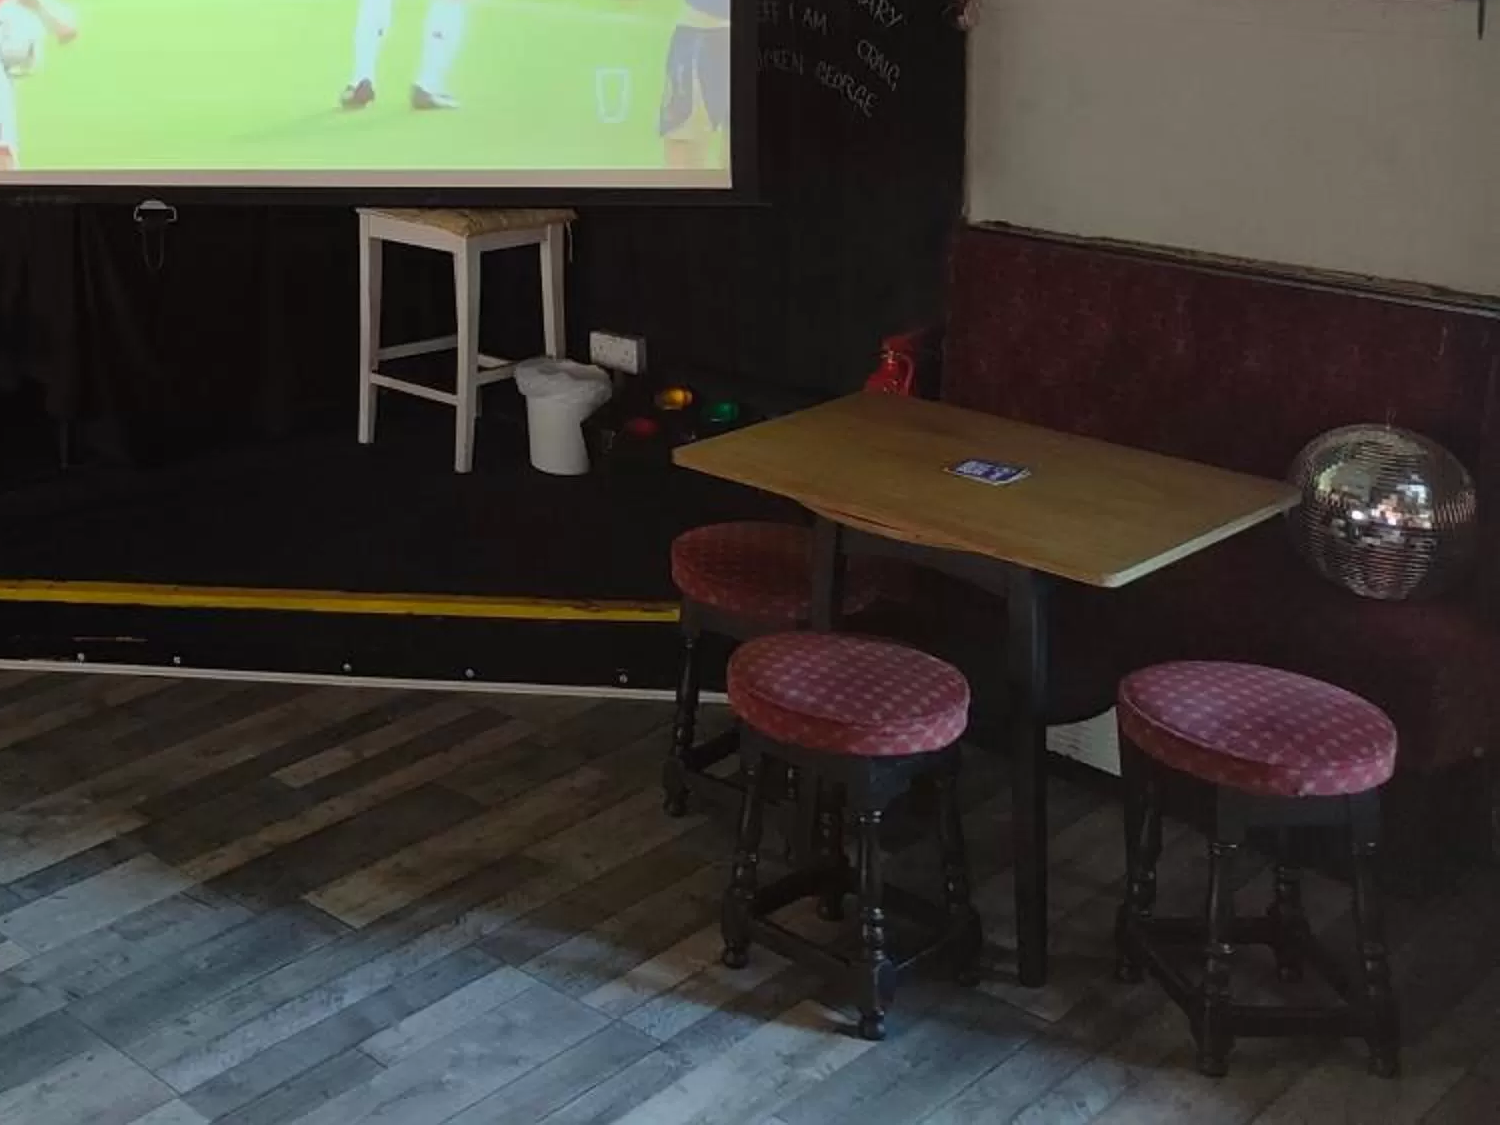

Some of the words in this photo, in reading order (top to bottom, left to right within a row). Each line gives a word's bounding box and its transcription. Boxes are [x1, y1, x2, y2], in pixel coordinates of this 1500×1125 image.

[802, 7, 828, 36] AM
[815, 60, 880, 118] GEORGE
[856, 38, 901, 91] CRAIG
